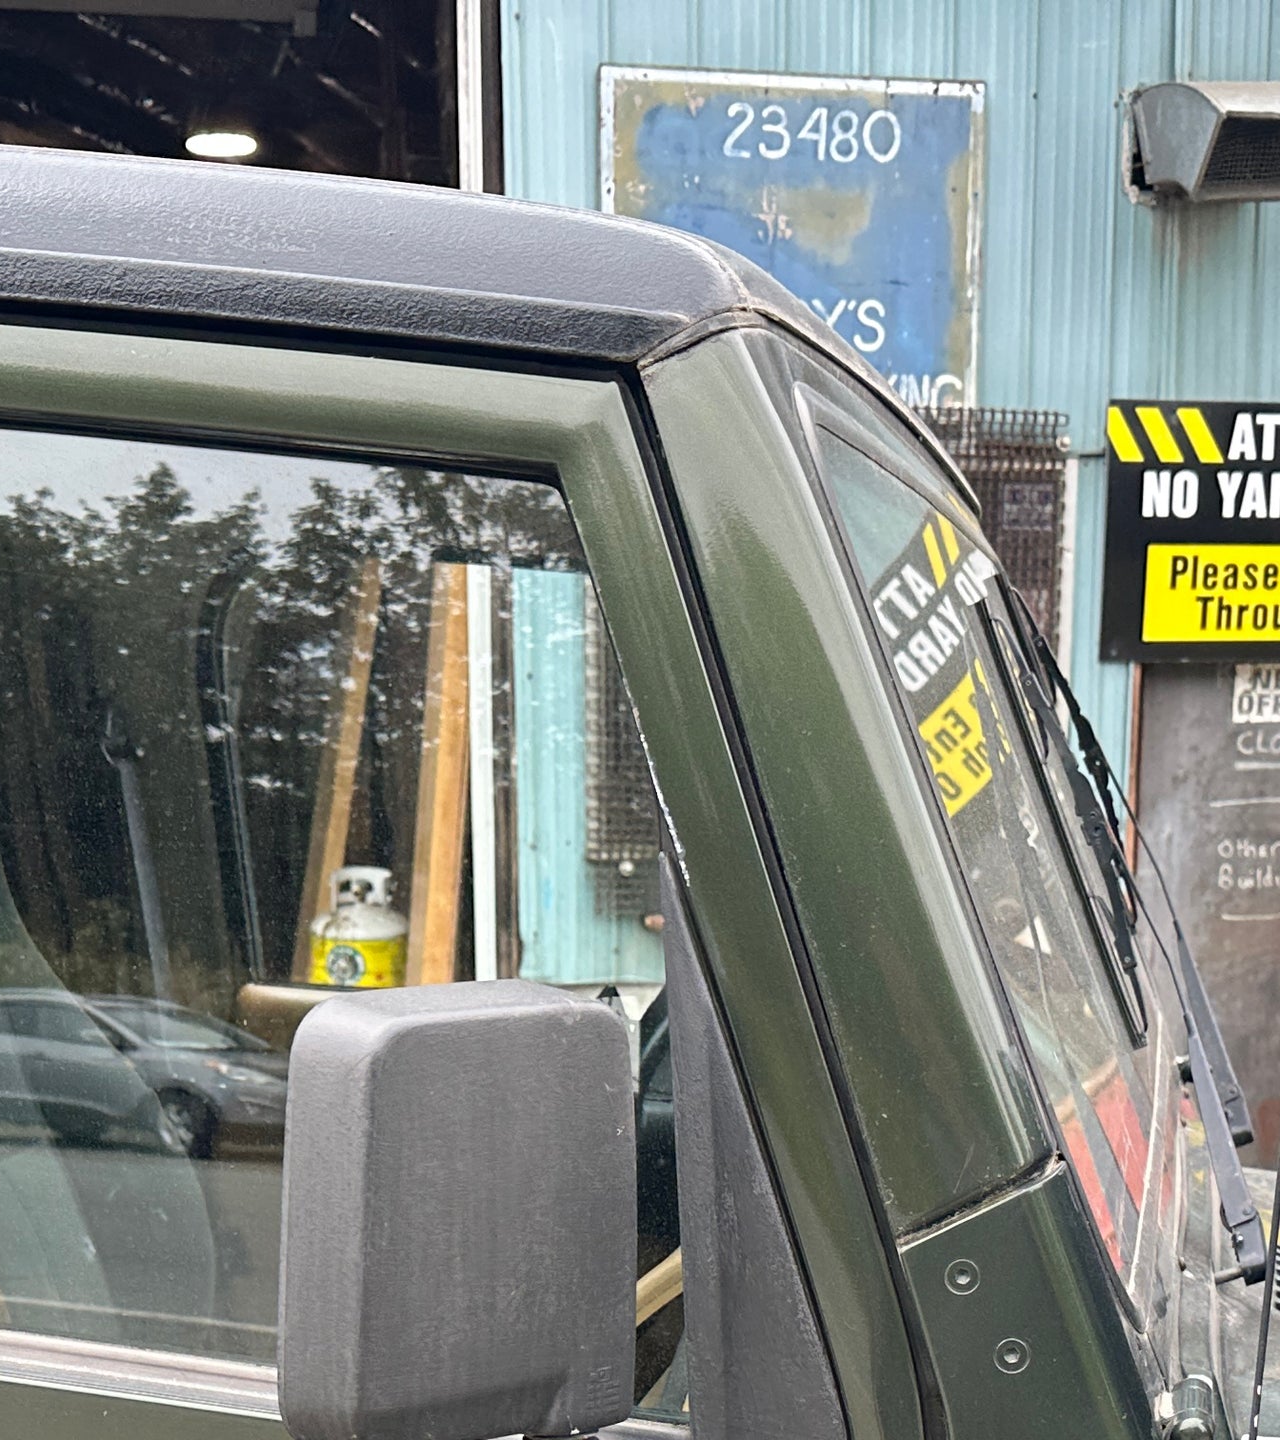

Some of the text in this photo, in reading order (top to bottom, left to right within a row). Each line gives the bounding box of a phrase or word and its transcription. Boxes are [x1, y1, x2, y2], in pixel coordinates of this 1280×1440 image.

[722, 102, 902, 163] 23480
[1142, 470, 1199, 518] NO
[1170, 556, 1278, 590] Please
